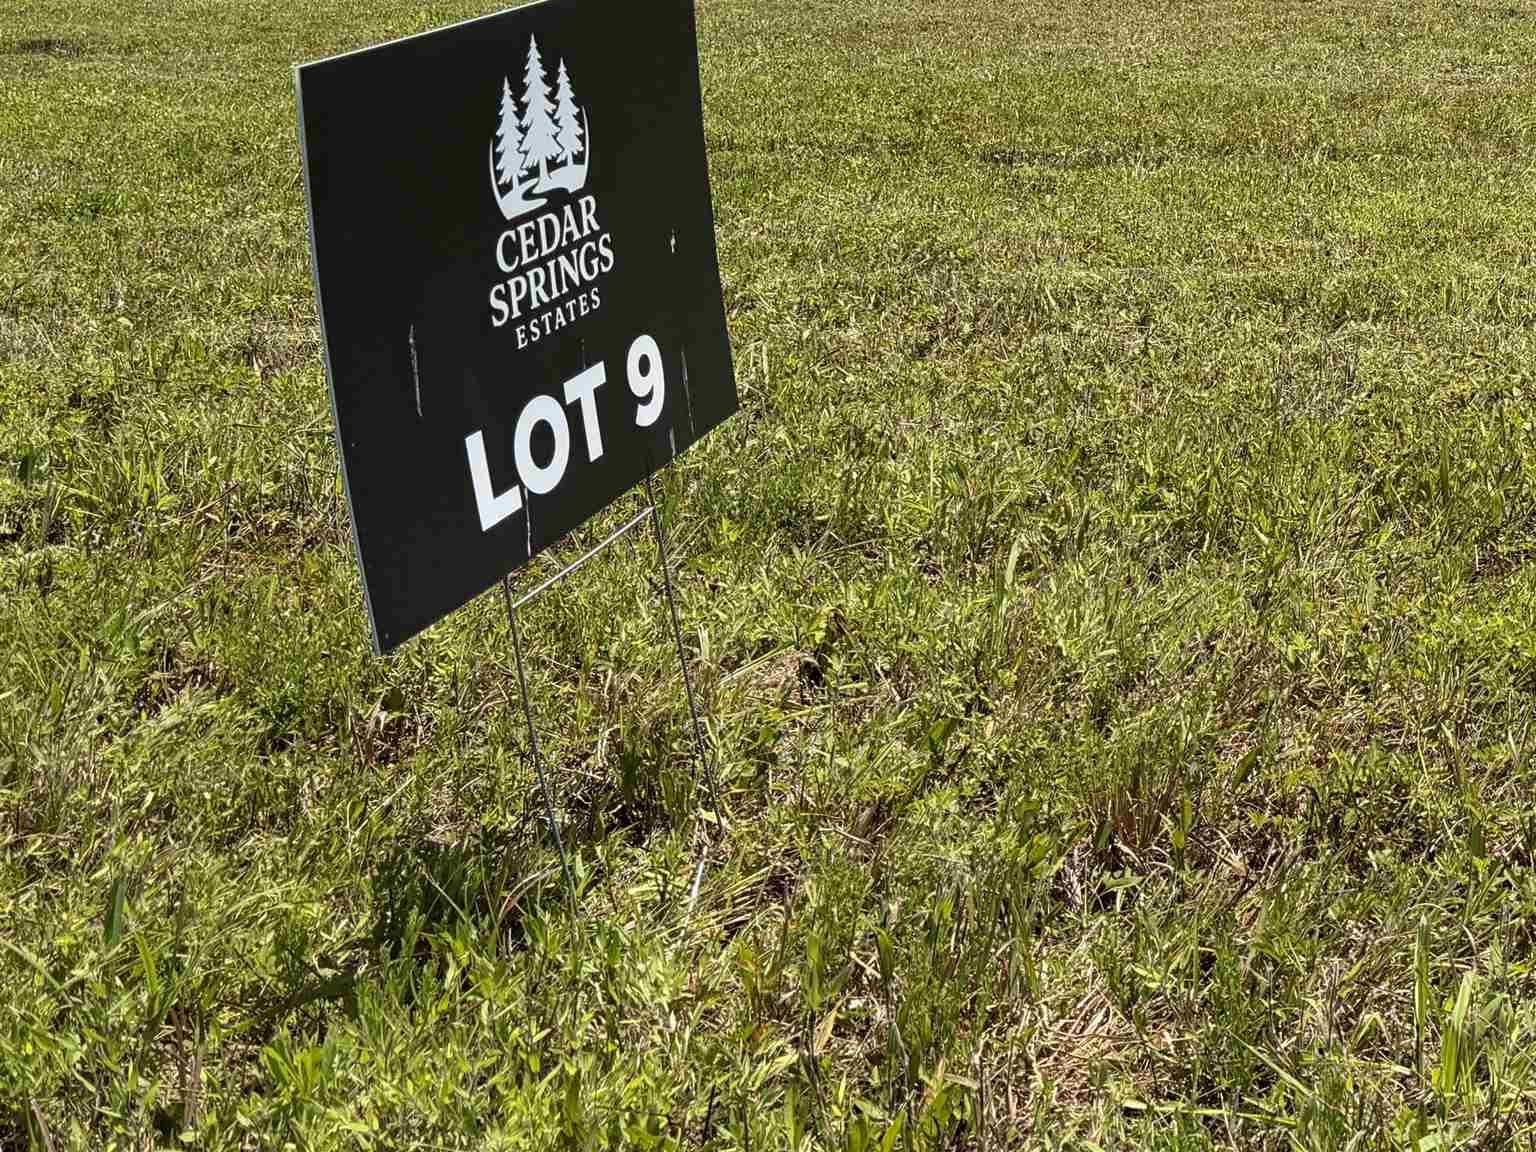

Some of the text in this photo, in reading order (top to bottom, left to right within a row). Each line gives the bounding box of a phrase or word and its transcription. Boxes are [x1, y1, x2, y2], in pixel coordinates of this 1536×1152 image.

[496, 195, 600, 273] CEDAR
[489, 233, 614, 327] SPRINGS
[515, 287, 601, 350] ESTATES
[464, 334, 665, 532] LOT 9
